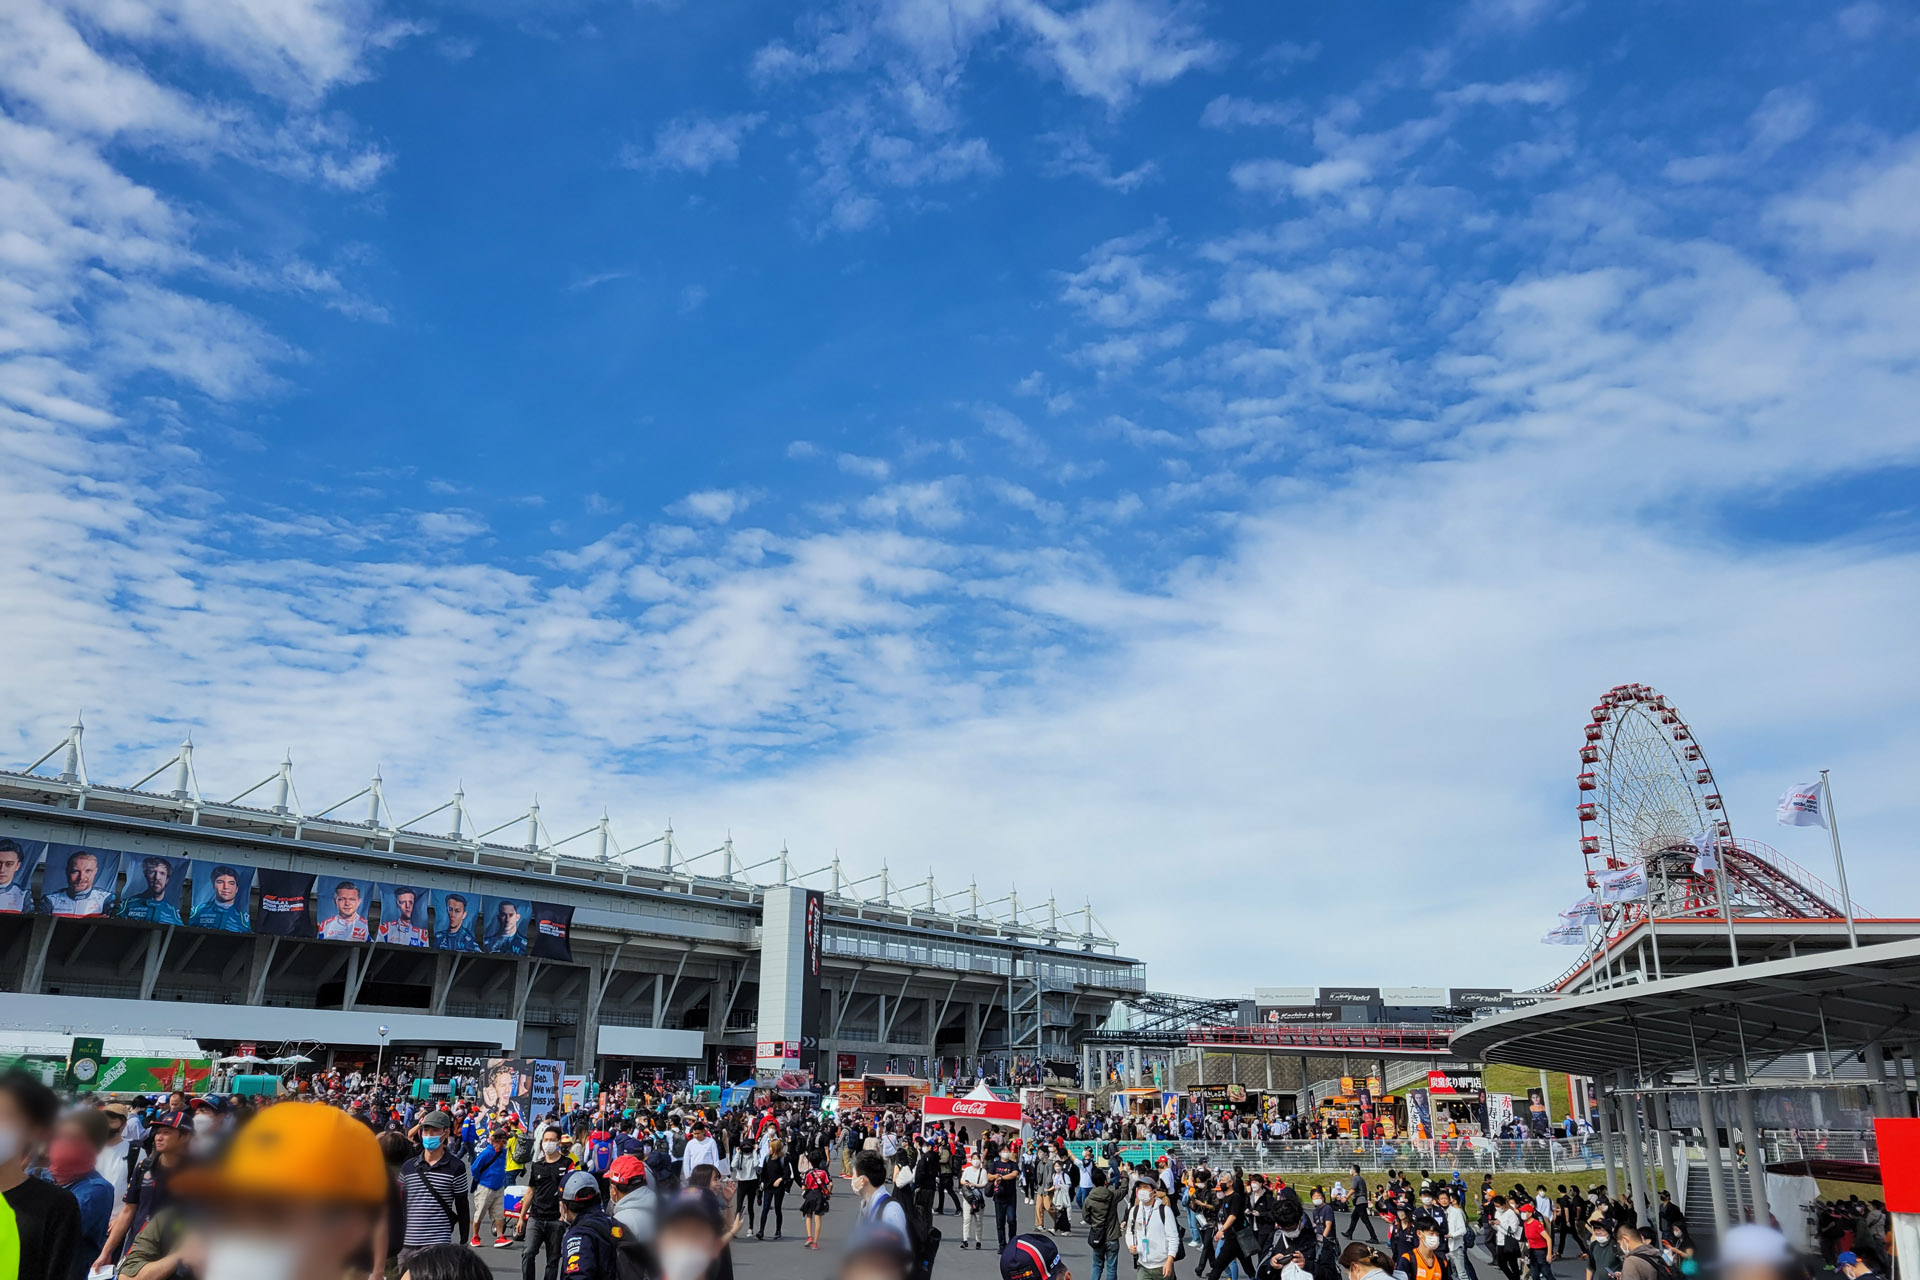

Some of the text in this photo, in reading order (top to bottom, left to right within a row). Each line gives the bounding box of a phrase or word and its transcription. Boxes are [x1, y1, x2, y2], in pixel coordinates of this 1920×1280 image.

[437, 1055, 482, 1067] FERRA
[536, 1062, 557, 1073] Danke
[534, 1084, 545, 1095] We
